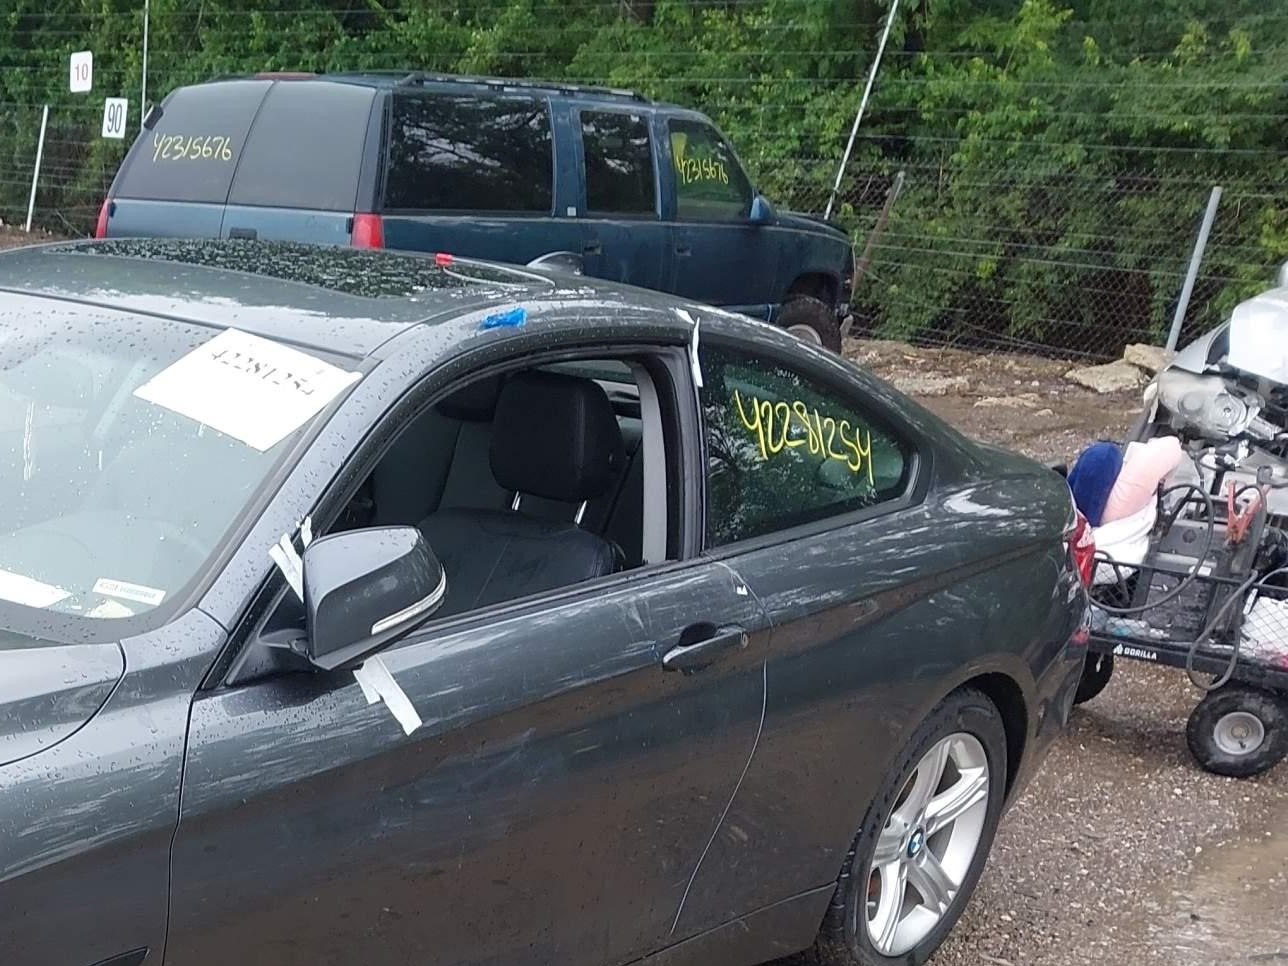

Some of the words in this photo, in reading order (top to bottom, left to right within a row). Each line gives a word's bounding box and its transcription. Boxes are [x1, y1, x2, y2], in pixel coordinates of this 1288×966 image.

[74, 63, 89, 81] 10
[107, 103, 122, 133] 90
[153, 132, 232, 162] 42315676
[676, 155, 729, 185] 42315676
[734, 388, 874, 487] 42281254
[1124, 647, 1157, 661] GORILLA
